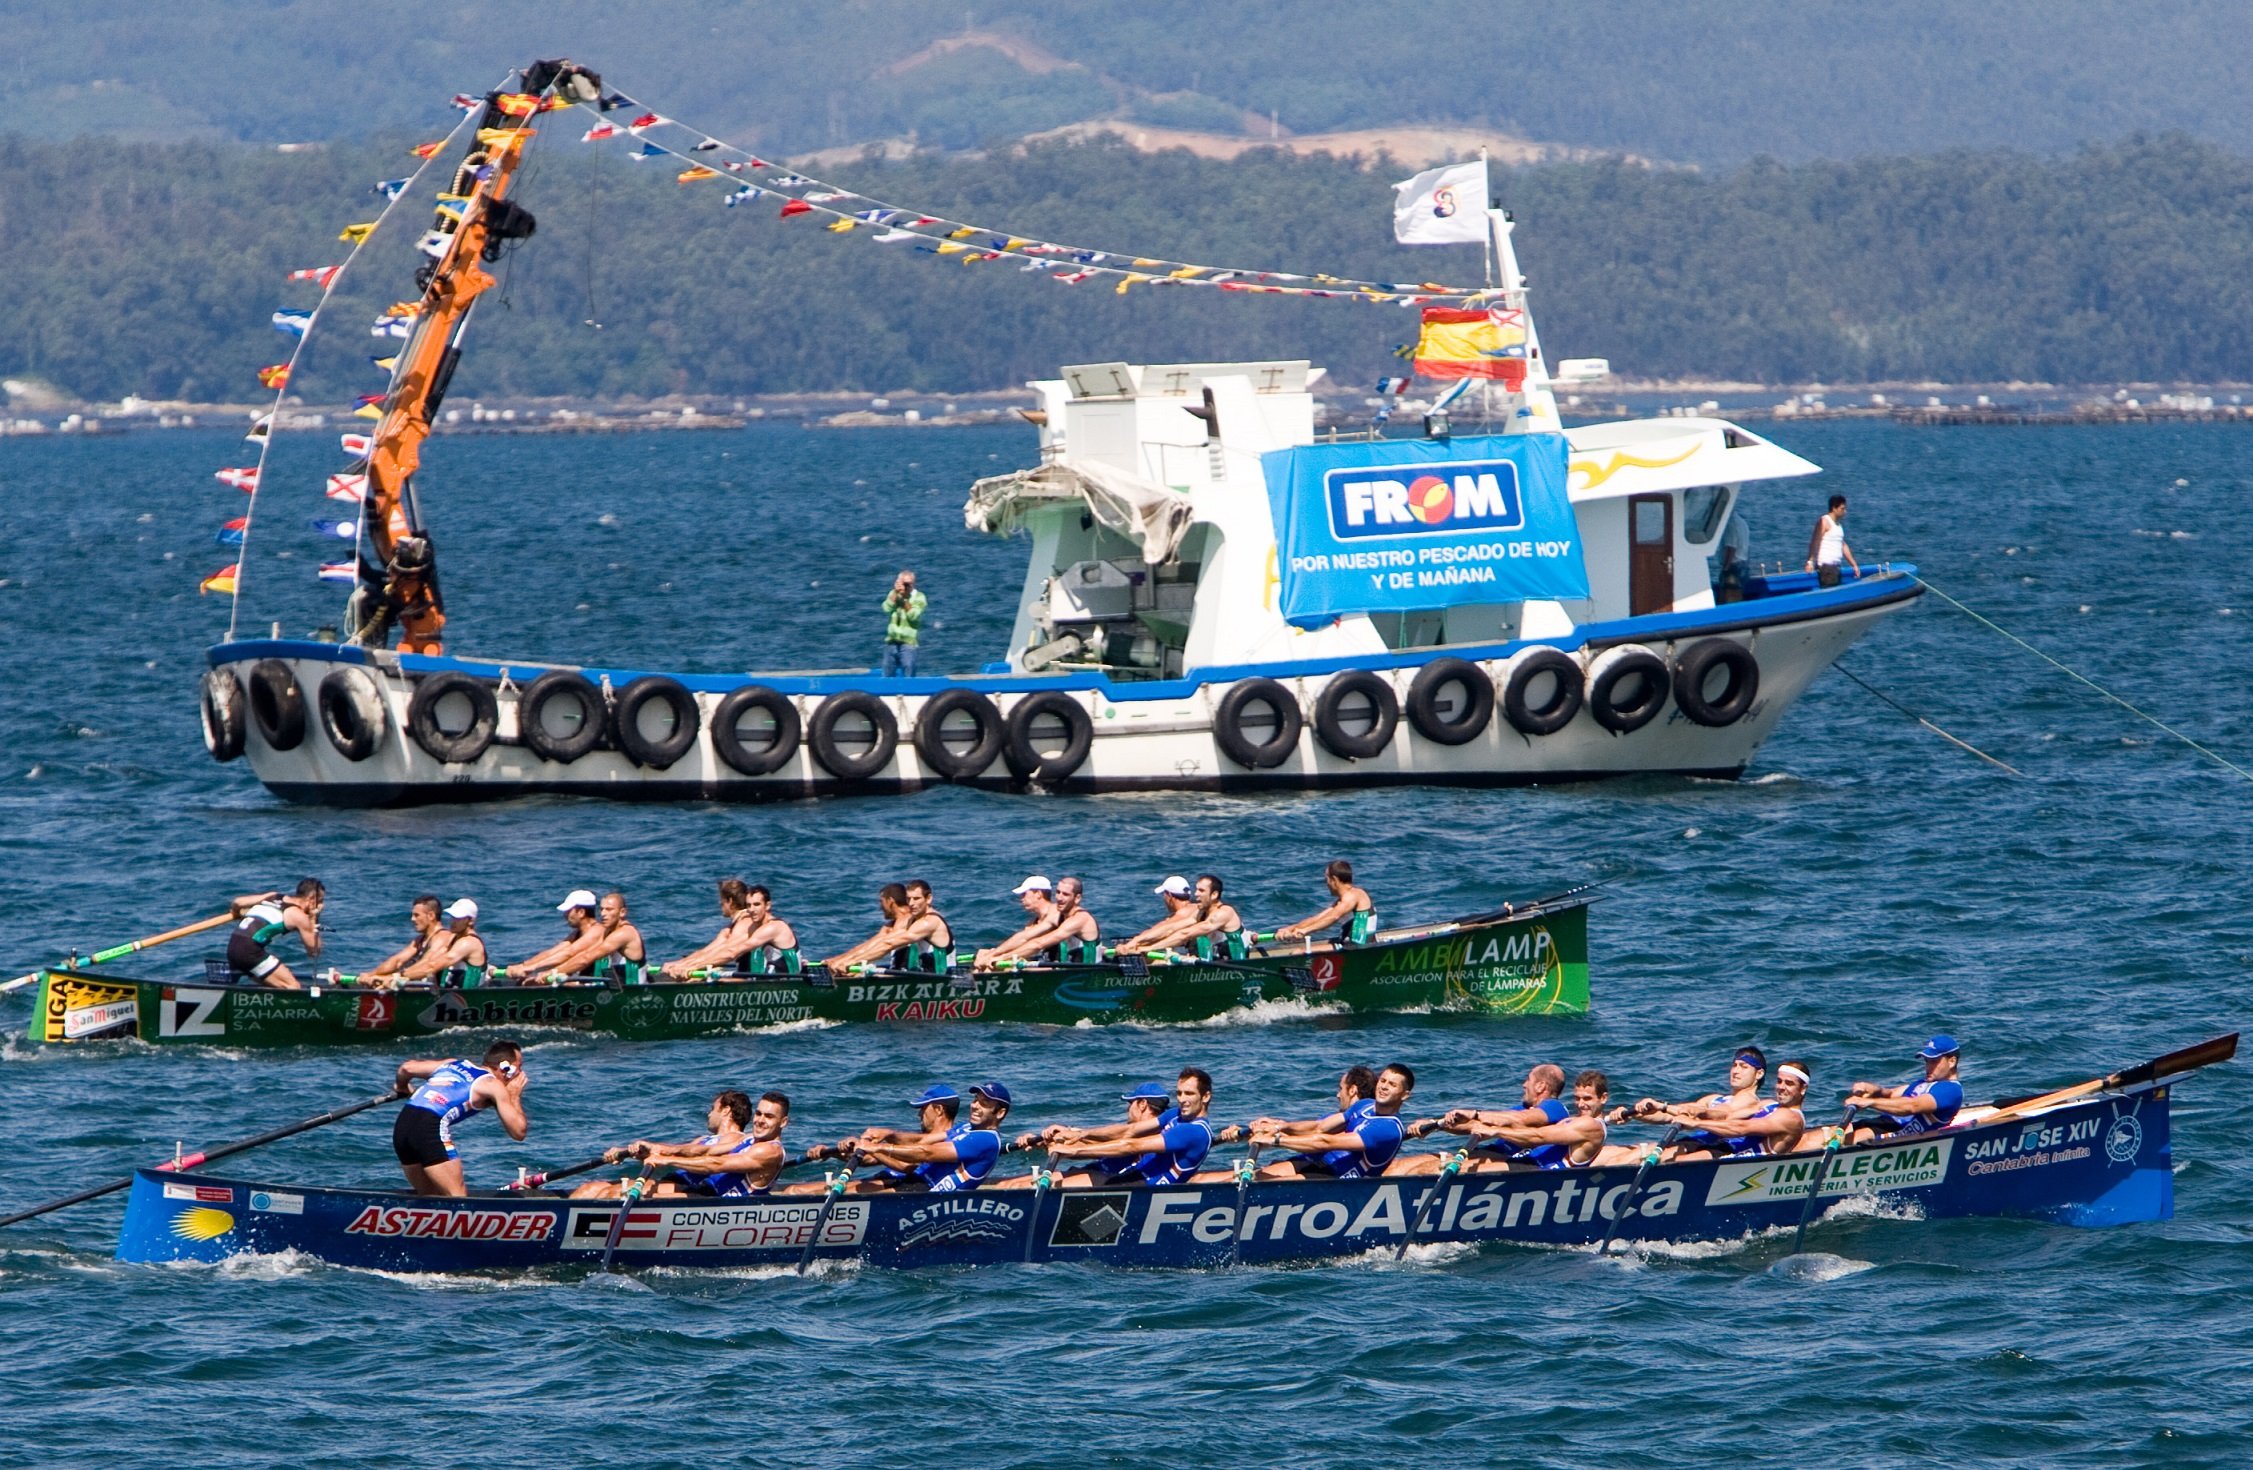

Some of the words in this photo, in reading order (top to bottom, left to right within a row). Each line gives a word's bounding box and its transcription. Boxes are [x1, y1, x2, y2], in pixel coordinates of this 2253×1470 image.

[1343, 473, 1507, 526] FROM
[1292, 556, 1330, 573] POR
[1333, 549, 1415, 570] NUESTRO
[1419, 543, 1506, 564] PESCADO
[1509, 541, 1533, 558] DE
[1536, 540, 1572, 557] HOY
[1371, 574, 1385, 590] Y
[1389, 572, 1415, 589] DE
[1418, 566, 1496, 587] MAÑANA
[1370, 971, 1444, 985] ASOCIACIÓN
[1446, 970, 1475, 981] PARA
[1478, 967, 1490, 978] EL
[1492, 963, 1548, 977] RECICLAJE
[1470, 981, 1486, 992] DE
[1487, 976, 1548, 992] LÁMPARAS
[232, 992, 275, 1007] IBAR
[433, 998, 597, 1023] habidite
[673, 989, 800, 1009] CONSTRUCCIONES
[875, 998, 986, 1022] KAIKU
[232, 1020, 265, 1032] S.A.
[669, 1009, 733, 1024] NAVALES
[735, 1007, 763, 1021] DEL
[765, 1005, 814, 1021] NORTE
[1964, 1137, 2008, 1160] SAN
[2067, 1117, 2101, 1142] XIV
[1968, 1151, 2049, 1176] Cantabria
[2051, 1146, 2091, 1164] Infinita
[1768, 1181, 1849, 1197] INGENERIA
[1853, 1179, 1864, 1188] Y
[1865, 1169, 1938, 1187] SERVICIOS
[671, 1206, 861, 1226] CONSTRUCCIONES
[898, 1198, 1025, 1231] ASTILLERO
[1139, 1172, 1684, 1244] FerroAtlántica
[345, 1206, 558, 1240] ASTANDER
[665, 1223, 858, 1248] FLORES
